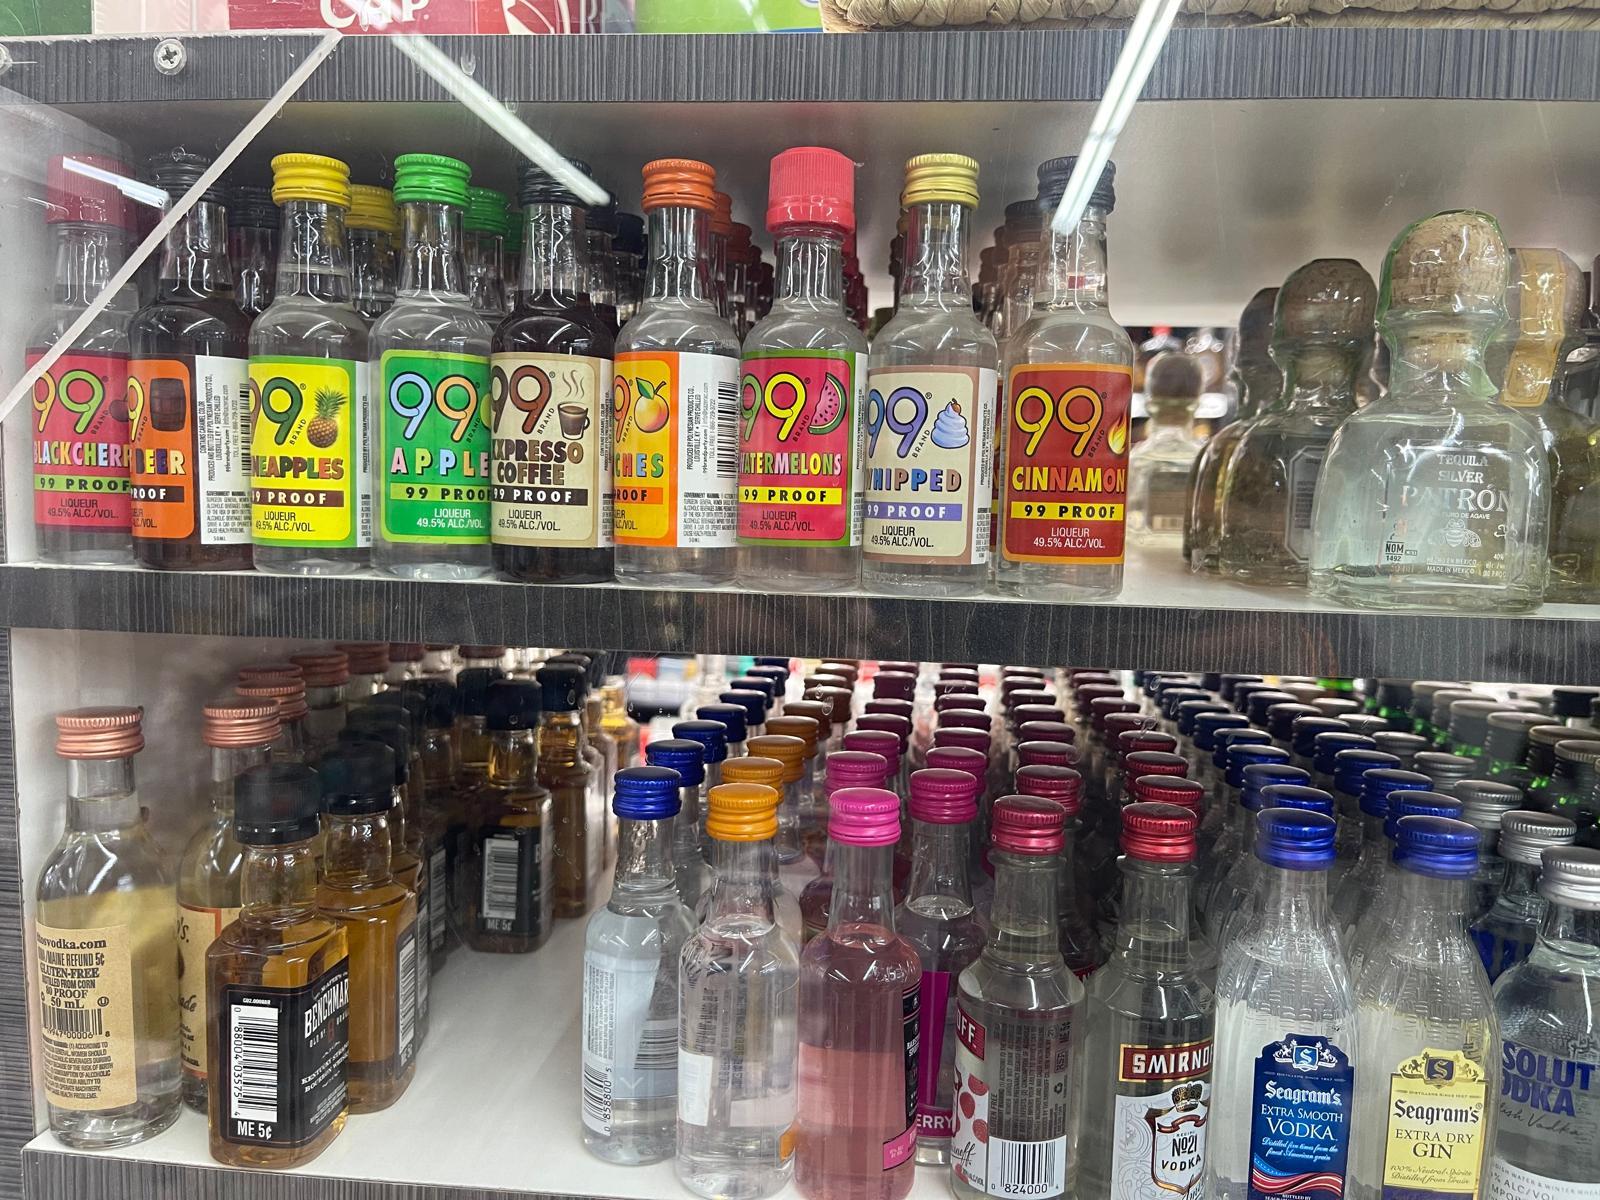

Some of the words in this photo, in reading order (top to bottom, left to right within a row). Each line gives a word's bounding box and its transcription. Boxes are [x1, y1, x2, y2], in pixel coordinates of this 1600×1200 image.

[389, 371, 478, 443] 99
[492, 364, 553, 435] 99
[740, 371, 807, 442] 99
[537, 407, 555, 435] BRAND
[1015, 385, 1104, 458] 99
[289, 418, 307, 446] BRAND
[467, 417, 481, 444] BRAND
[622, 415, 633, 443] BRAND
[792, 414, 811, 444] BRAND
[912, 429, 931, 458] BRAND
[1088, 430, 1105, 458] BRAND
[1436, 454, 1489, 467] TEQUILA
[497, 461, 565, 486] COFFEE
[1011, 466, 1126, 493] CINNAMON
[1437, 470, 1485, 484] SILVER
[40, 476, 56, 489] 99
[65, 478, 130, 493] PROOF
[267, 491, 327, 505] PROOF
[405, 486, 429, 499] 99
[493, 487, 505, 500] 99
[513, 489, 572, 503] PROOF
[744, 488, 758, 501] 99
[767, 489, 827, 502] PROOF
[60, 497, 98, 509] LIQUEUR
[264, 511, 297, 521] LIQUEUR
[434, 508, 471, 519] LIQUEUR
[508, 509, 542, 520] LIQUEUR
[762, 510, 797, 521] LIQUEUR
[867, 505, 879, 517] 99
[887, 505, 946, 518] PROOF
[1024, 504, 1047, 517] 99
[1058, 505, 1115, 519] PROOF
[1470, 512, 1491, 520] AGAVE
[255, 521, 273, 531] 49.5%
[273, 521, 316, 532] ALC./VOL.
[416, 518, 446, 528] 49.5%
[498, 519, 517, 529] 49.5%
[518, 520, 561, 531] ALC./VOL.
[750, 520, 772, 530] 49.5%
[772, 521, 816, 532] ALC./VOL.
[881, 525, 916, 536] LIQUEUR
[1051, 527, 1090, 537] LIQUEUR
[871, 535, 891, 545] 49.5%
[891, 536, 934, 548] ALC./VOL.
[1033, 538, 1062, 548] 49.5%
[1064, 538, 1106, 549] ALC./VOL.
[1385, 543, 1404, 553] NOM
[66, 953, 94, 967] REFUND
[95, 952, 105, 966] 5¢
[40, 962, 100, 979] GLUTEN-FREE
[61, 979, 77, 989] FROM
[77, 979, 96, 989] CORN
[54, 987, 89, 999] PROOF
[51, 996, 61, 1007] 50
[64, 998, 85, 1009] mL
[304, 978, 349, 1039] BENCHMAR
[1502, 1040, 1596, 1091] SOLUT
[1264, 1080, 1342, 1106] Seagram's
[1261, 1103, 1295, 1118] EXTRA
[1297, 1108, 1344, 1123] SMOOTH
[1393, 1099, 1480, 1126] Seagram's
[237, 1121, 255, 1137] ME
[258, 1122, 272, 1140] 5¢
[1266, 1117, 1334, 1141] VODKA
[1395, 1128, 1441, 1141] EXTRA
[1446, 1132, 1475, 1144] DRY
[1412, 1142, 1454, 1160] GIN
[1161, 1153, 1202, 1171] VODKA
[1004, 1183, 1048, 1195] 824000
